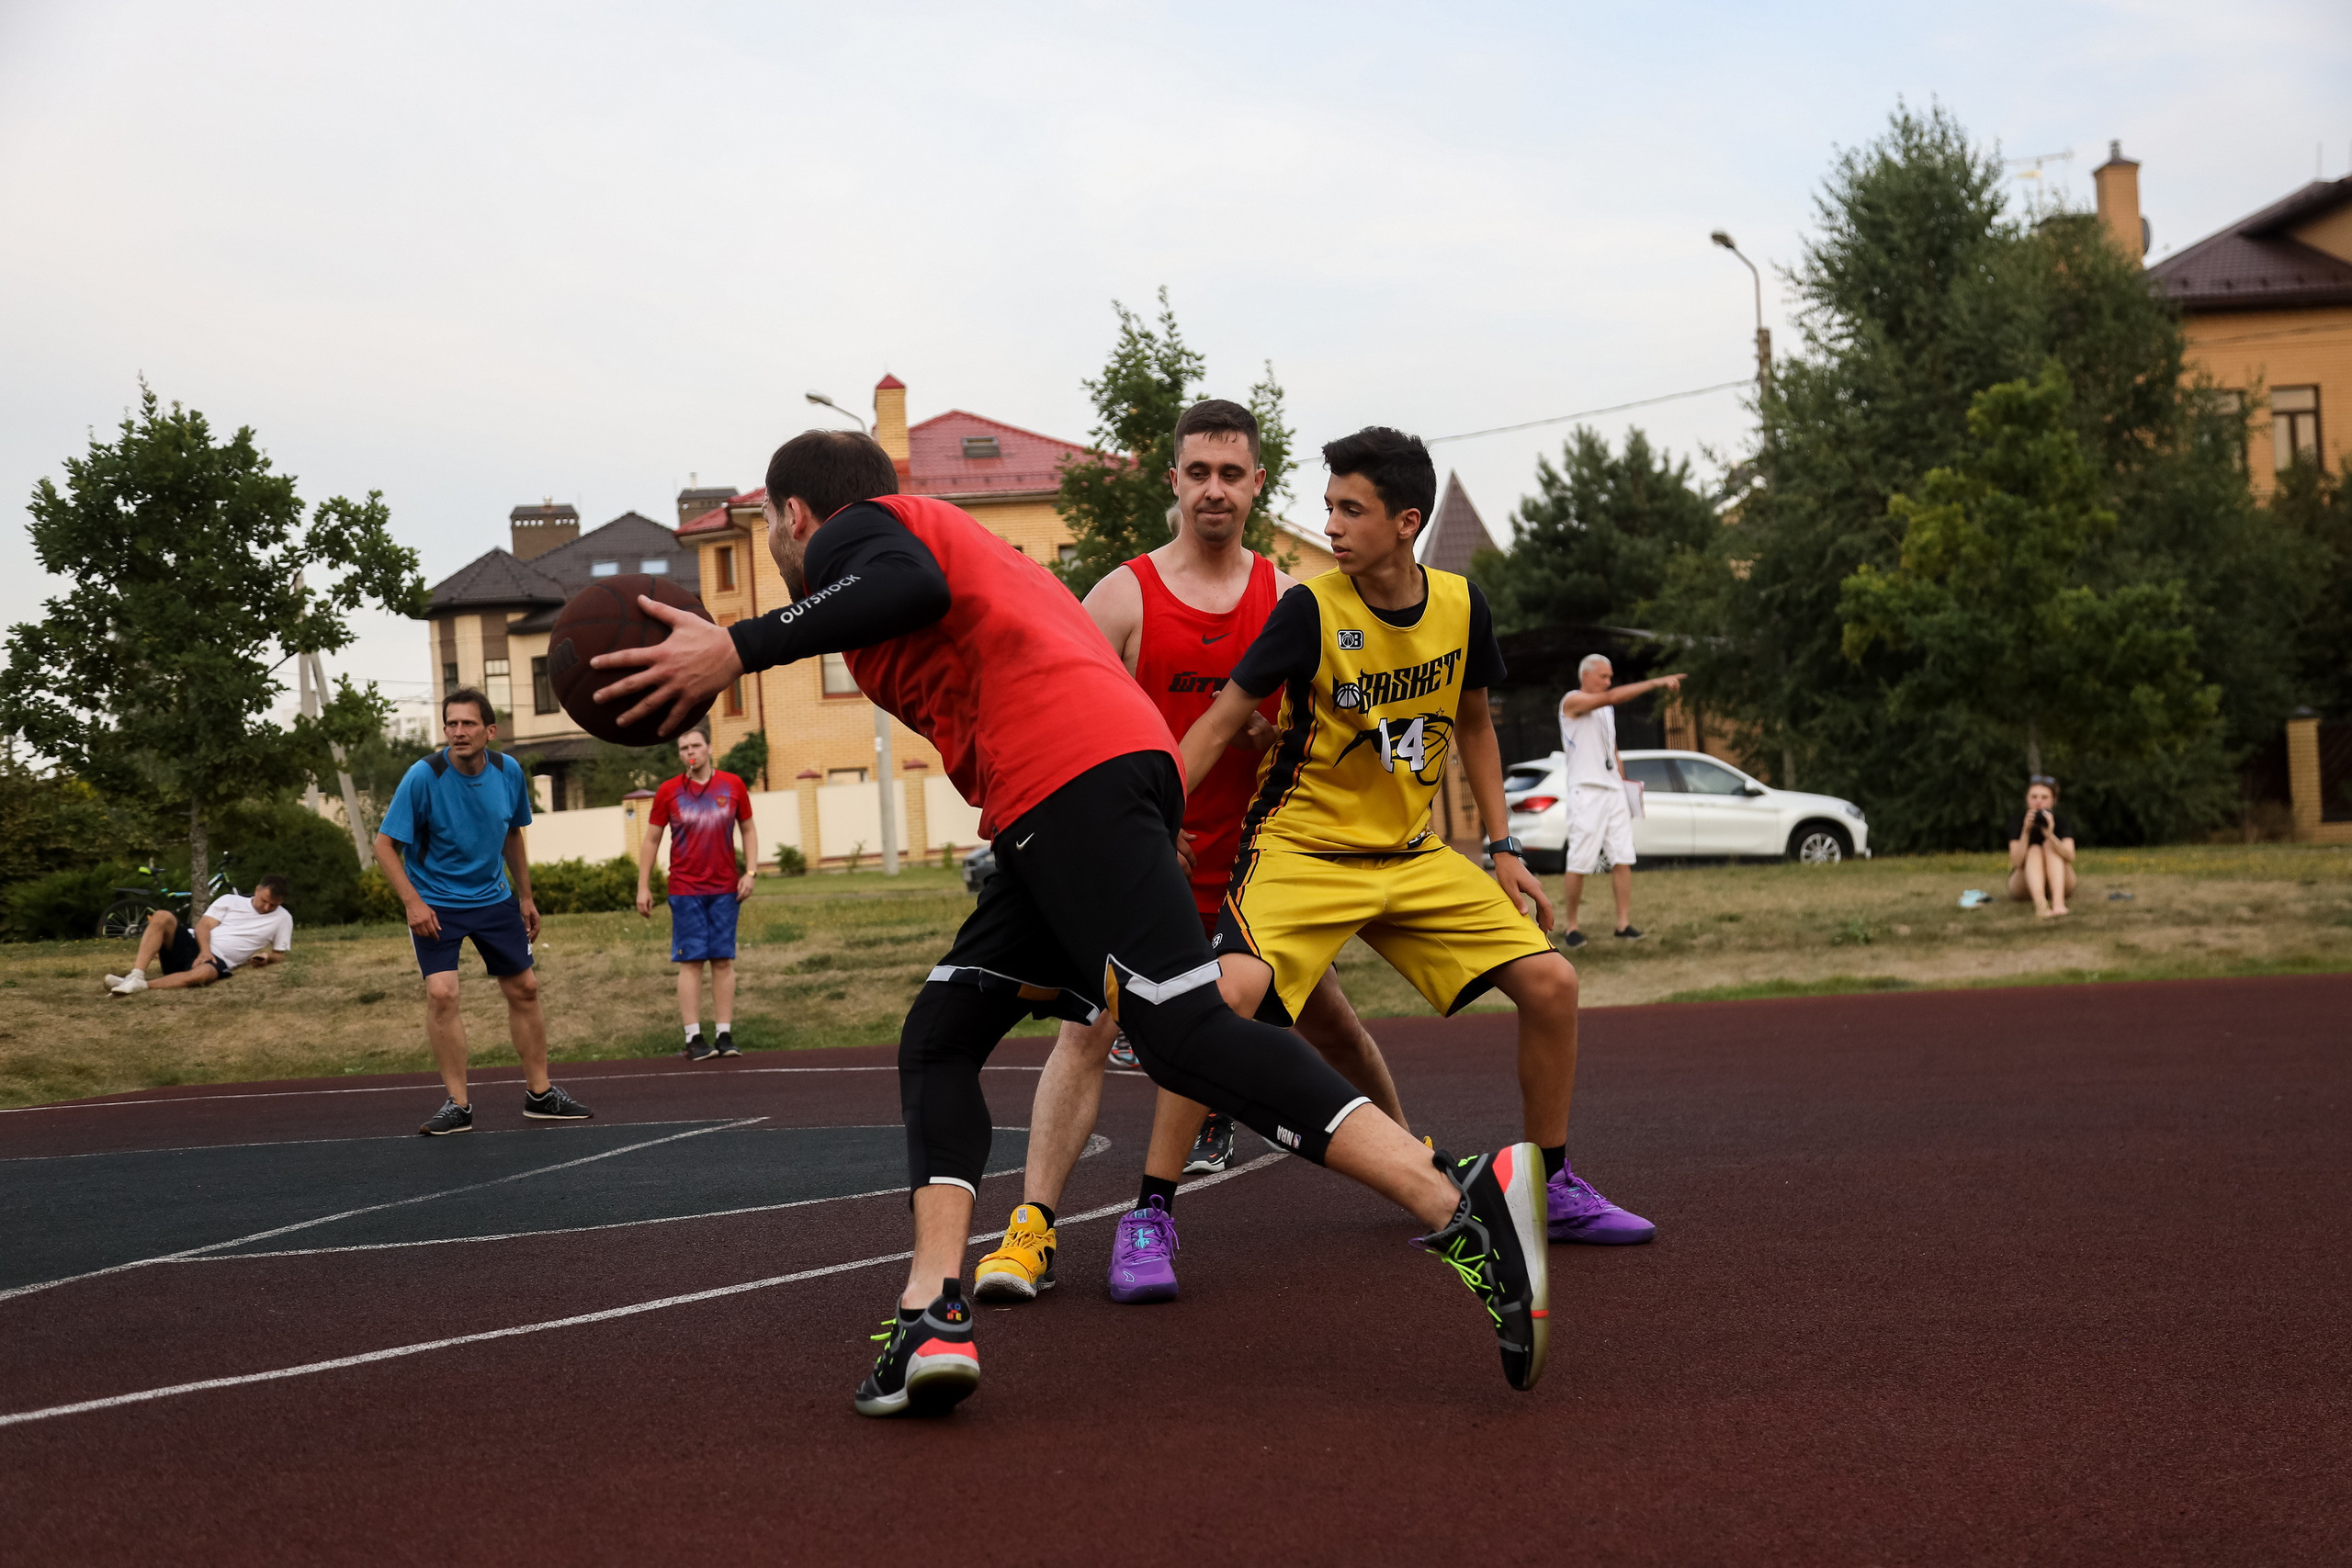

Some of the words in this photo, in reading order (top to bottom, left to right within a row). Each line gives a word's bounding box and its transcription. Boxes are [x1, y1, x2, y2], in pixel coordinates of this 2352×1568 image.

[779, 573, 862, 624] OUTSHOCK
[1357, 647, 1462, 715] BASKET
[1377, 716, 1425, 774] 14
[1276, 1124, 1295, 1146] NBA
